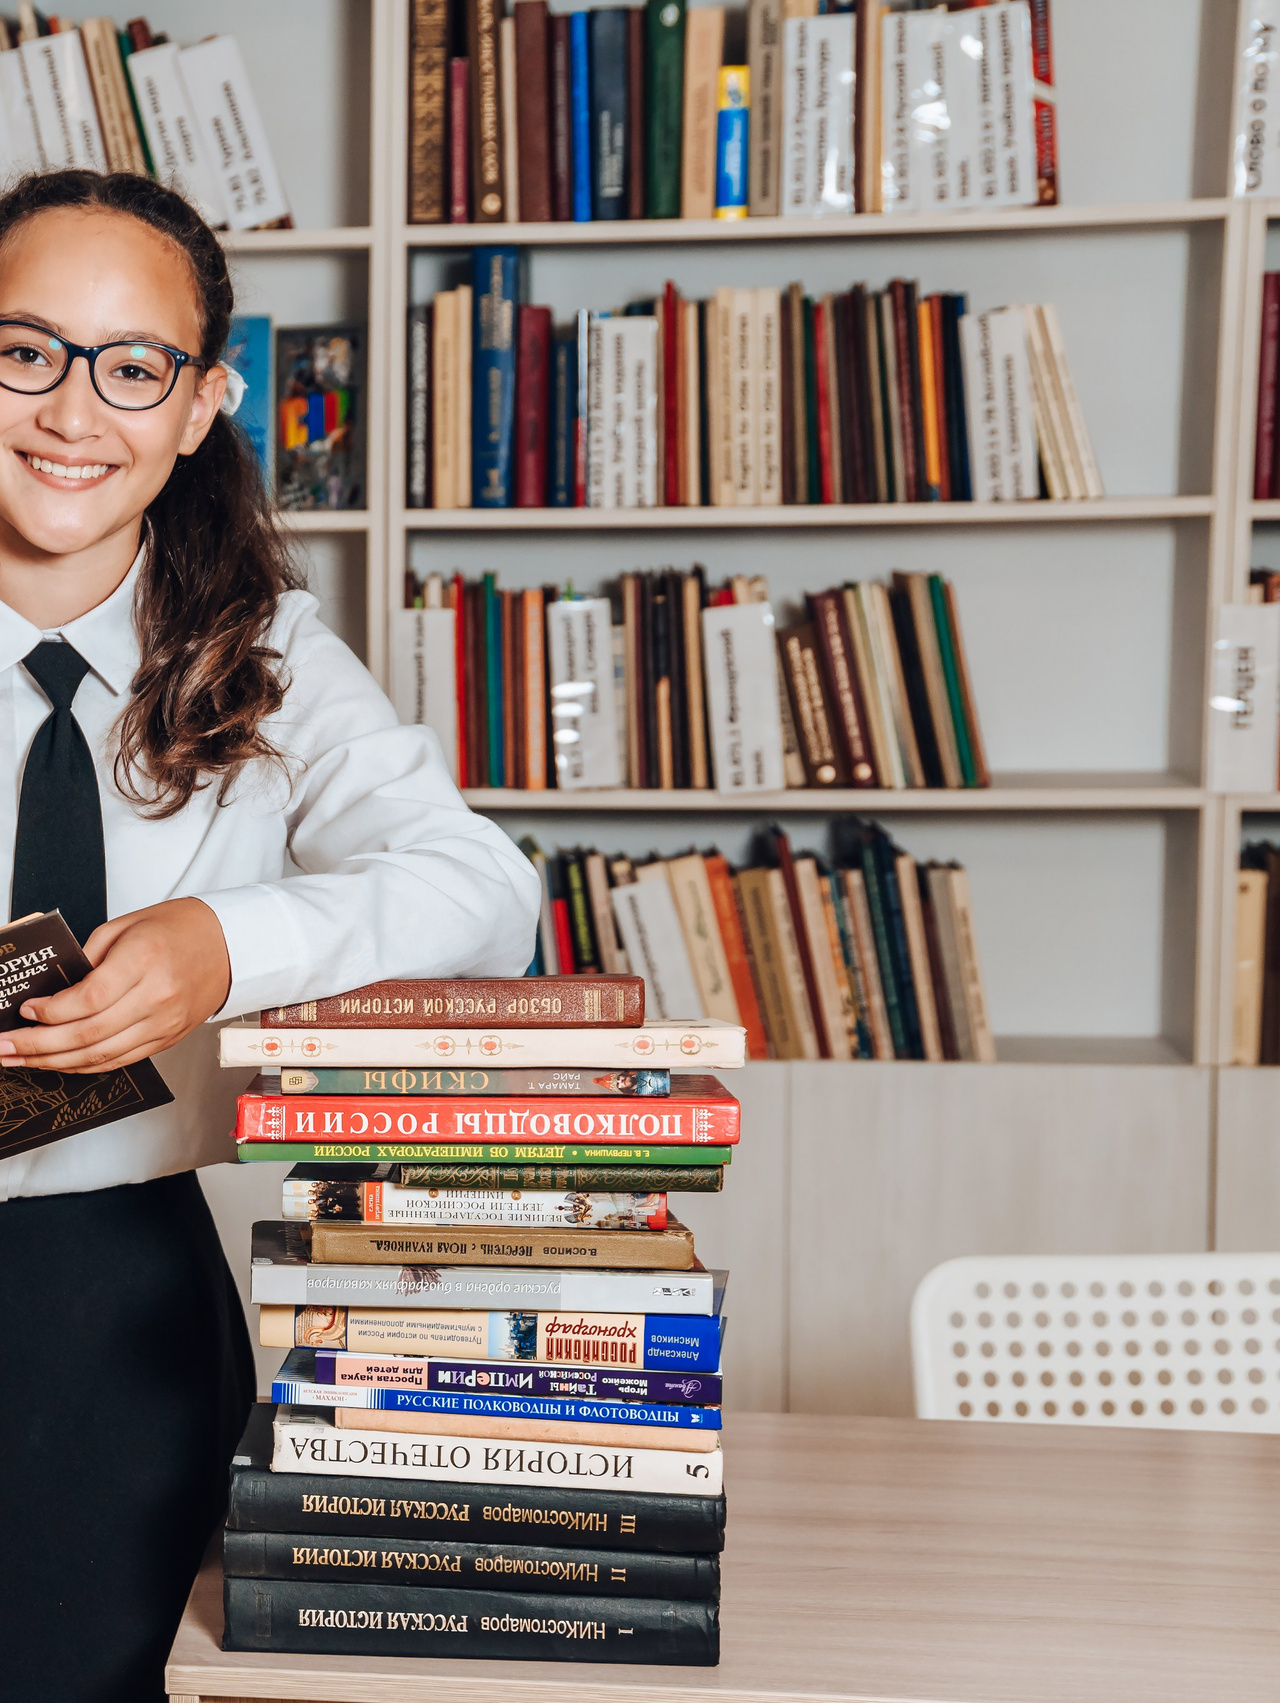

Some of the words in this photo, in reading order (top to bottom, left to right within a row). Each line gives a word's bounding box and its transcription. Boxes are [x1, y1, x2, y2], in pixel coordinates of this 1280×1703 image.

[340, 998, 414, 1014] ИСТОРИИ
[424, 997, 496, 1017] РУССКОЙ
[508, 998, 562, 1014] ОБЗОР
[364, 1069, 490, 1094] СКИФЫ
[553, 1072, 581, 1081] РАЙС
[295, 1110, 440, 1136] РОССИИ
[456, 1108, 682, 1137] ПОЛКОВОДЦЫ
[314, 1145, 371, 1158] РОССИИ
[377, 1146, 484, 1159] ИМПЕРАТОРАХ
[490, 1147, 509, 1158] ОБ
[515, 1146, 566, 1159] ДЕТЯМ
[584, 1148, 633, 1158] ПЕРВУШИНА
[635, 1149, 642, 1158] В.
[644, 1149, 650, 1158] Е.
[446, 1190, 504, 1200] ИМПЕРИИ
[406, 1199, 485, 1211] РОССИЙСКОЙ
[491, 1201, 544, 1212] ДЕЯТЕЛИ
[387, 1210, 503, 1221] ГОСУДАРСТВЕННЫЕ
[508, 1213, 563, 1223] ВЕЛИКИЕ
[437, 1241, 468, 1254] ПОЛЯ
[480, 1243, 533, 1257] ПЕРСТЕНЬ
[543, 1247, 597, 1257] В.ОСИПОВ
[307, 1278, 372, 1290] кавалеров
[376, 1279, 453, 1296] биографиях
[455, 1282, 462, 1290] в
[467, 1281, 511, 1294] ордена
[515, 1280, 561, 1295] русские
[351, 1316, 405, 1328] дополнениями
[408, 1319, 477, 1332] мультимедийными
[359, 1329, 385, 1339] России
[388, 1331, 417, 1339] истории
[546, 1320, 638, 1340] хронограф
[428, 1332, 483, 1344] Путеводитель
[652, 1334, 701, 1347] Мясников
[547, 1338, 638, 1364] РОССИЙСКИЙ
[648, 1346, 700, 1361] Александр
[341, 1372, 375, 1381] наука
[367, 1365, 404, 1375] детей
[408, 1367, 424, 1375] для
[378, 1375, 424, 1385] Простая
[603, 1376, 649, 1388] Можейко
[619, 1385, 649, 1396] Игорь
[396, 1394, 458, 1410] РУССКИЕ
[462, 1397, 561, 1416] ПОЛКОВОДЦЫ
[564, 1402, 574, 1414] И
[578, 1402, 678, 1423] ФЛОТОВОДЦЫ
[290, 1437, 470, 1468] ОТЕЧЕСТВА
[483, 1446, 634, 1478] ИСТОРИЯ
[685, 1464, 708, 1479] 5
[302, 1494, 386, 1517] ИСТОРИЯ
[391, 1499, 470, 1522] РУССКАЯ
[293, 1548, 378, 1571] ИСТОРИЯ
[383, 1551, 463, 1574] РУССКАЯ
[300, 1608, 383, 1630] ИСТОРИЯ
[388, 1612, 468, 1633] РУССКАЯ
